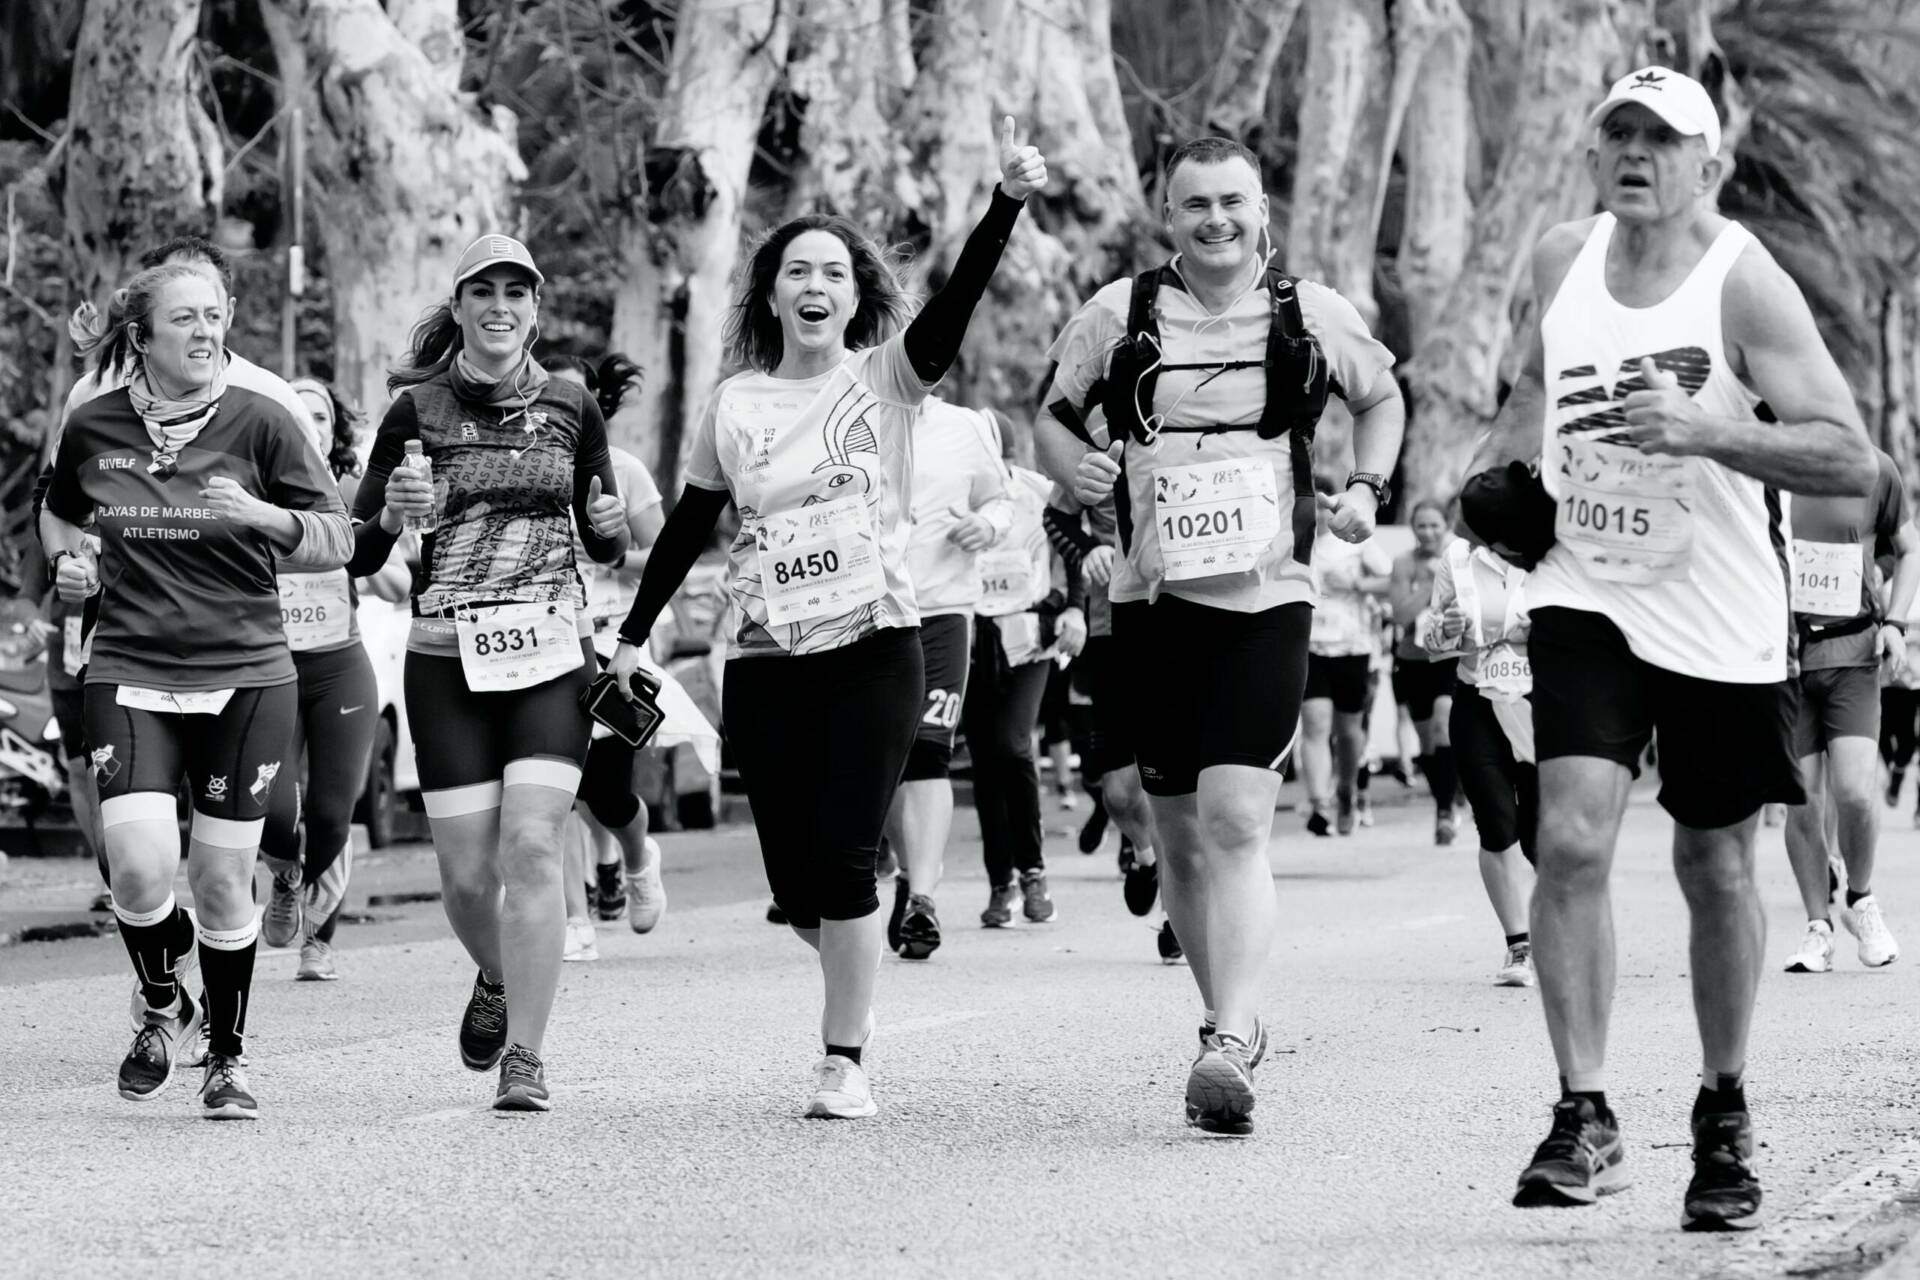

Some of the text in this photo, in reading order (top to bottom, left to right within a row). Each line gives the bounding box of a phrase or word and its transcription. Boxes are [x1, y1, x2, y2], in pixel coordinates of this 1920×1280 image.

[98, 458, 136, 470] RIVELF
[98, 506, 218, 520] PLAYAS DE MARBE
[1565, 495, 1650, 536] 10015
[122, 527, 200, 540] ATLETISMO
[1163, 507, 1243, 540] 10201
[774, 549, 839, 585] 8450
[1799, 572, 1840, 591] 1041
[280, 605, 327, 624] 0926
[474, 626, 539, 656] 8331
[1484, 661, 1532, 681] 10856
[922, 688, 961, 729] 20
